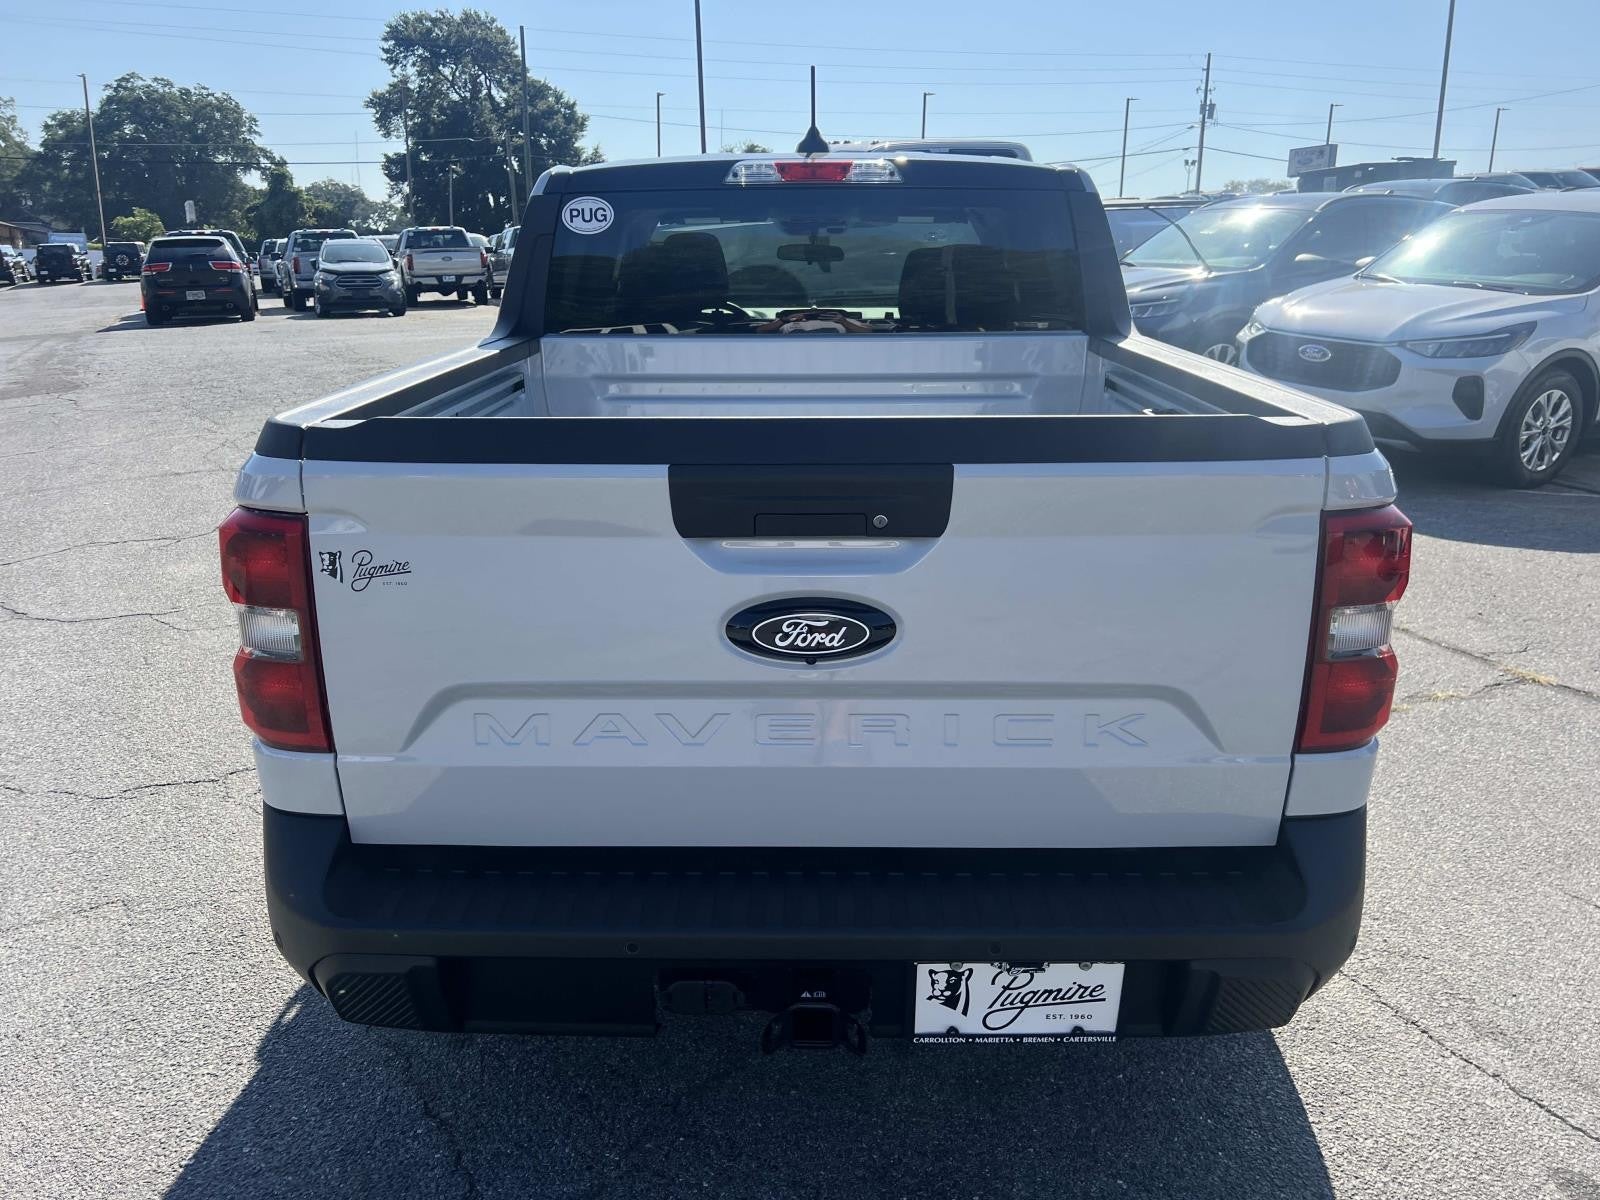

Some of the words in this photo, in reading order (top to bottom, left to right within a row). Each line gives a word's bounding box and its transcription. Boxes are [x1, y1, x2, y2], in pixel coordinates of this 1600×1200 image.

[569, 207, 608, 224] PUG
[351, 550, 411, 592] Pugmire
[774, 619, 848, 648] Ford
[472, 712, 1150, 747] MAVERICK
[981, 969, 1107, 1031] Pugmire
[1022, 1036, 1053, 1044] BREMEN
[1063, 1035, 1117, 1043] CARTERSVILLE
